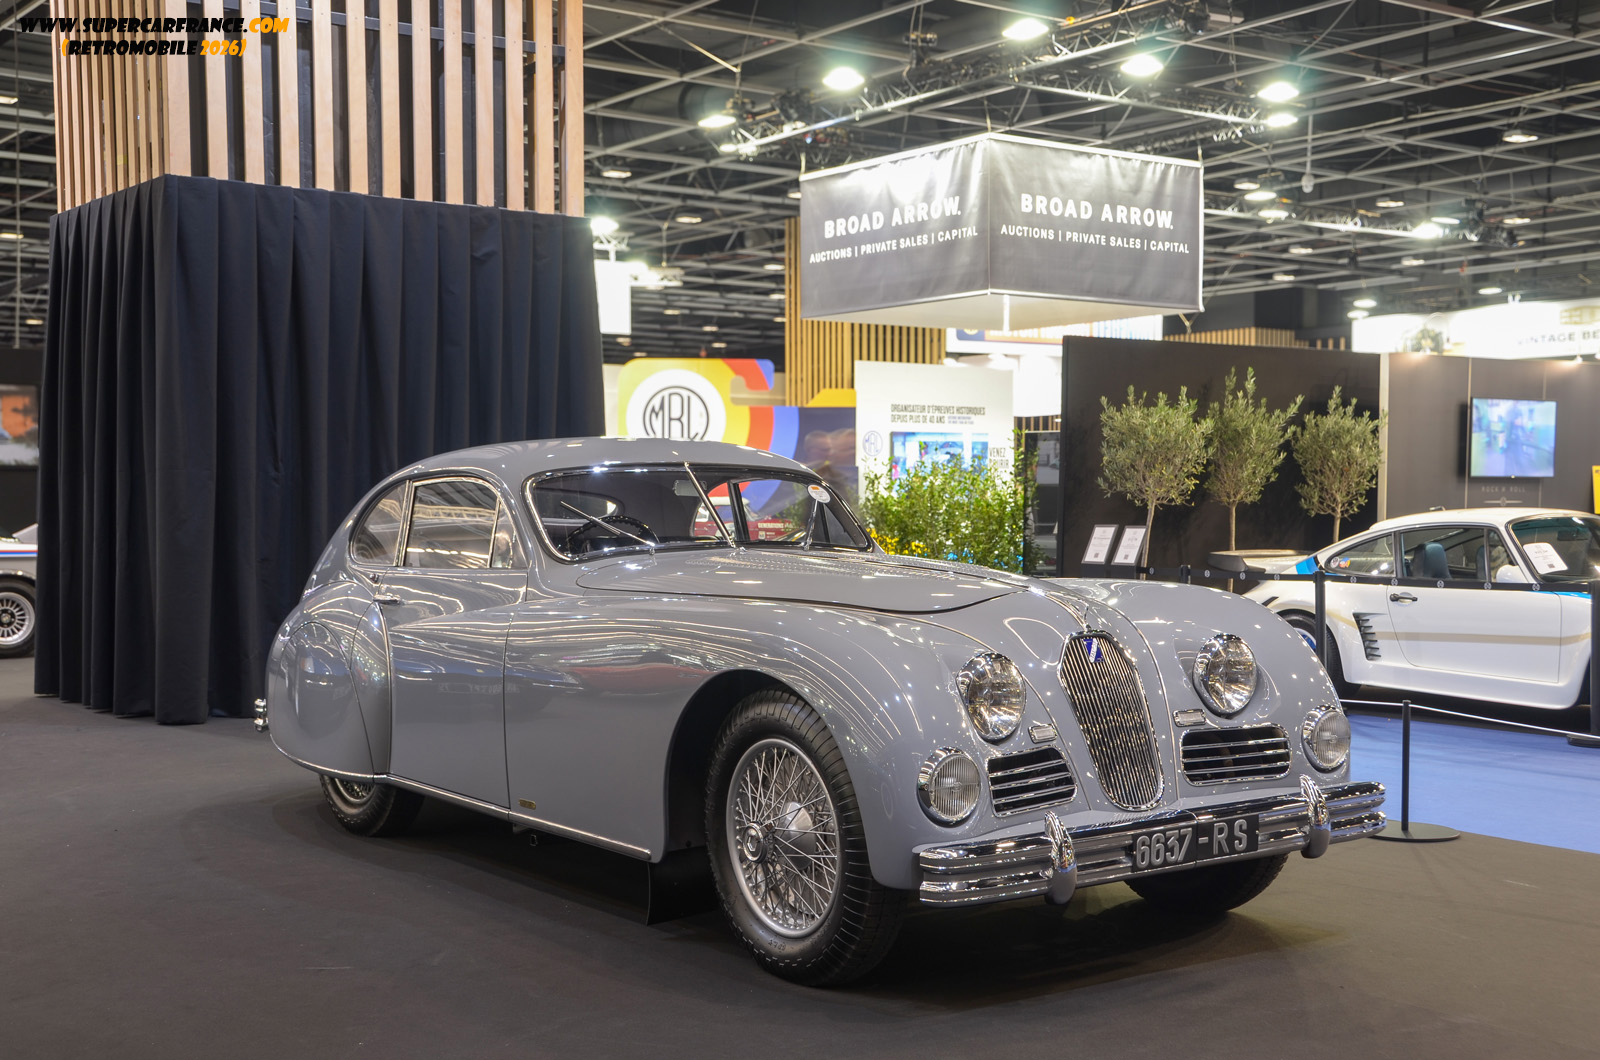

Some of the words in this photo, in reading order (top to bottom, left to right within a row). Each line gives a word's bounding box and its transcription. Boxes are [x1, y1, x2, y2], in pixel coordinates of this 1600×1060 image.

[1021, 193, 1093, 220] BROAD
[824, 211, 885, 239] BROAD
[809, 247, 852, 264] AUCTIONS
[860, 239, 897, 256] PRIVATE
[900, 233, 928, 249] SALES
[937, 226, 978, 243] CAPITAL
[1000, 224, 1055, 240] AUCTIONS
[1065, 231, 1106, 246] PRIVATE
[1110, 236, 1141, 249] SALES
[1150, 240, 1190, 254] CAPITAL
[649, 392, 699, 441] MRL
[891, 404, 926, 413] ORGANISATEUR
[956, 406, 986, 416] HISTORIQUES
[891, 414, 908, 423] DEPUIS
[909, 414, 921, 424] PLUS
[922, 415, 928, 424] DE
[929, 415, 935, 424] 40
[936, 416, 945, 424] ANS
[989, 447, 1006, 457] VENEZ
